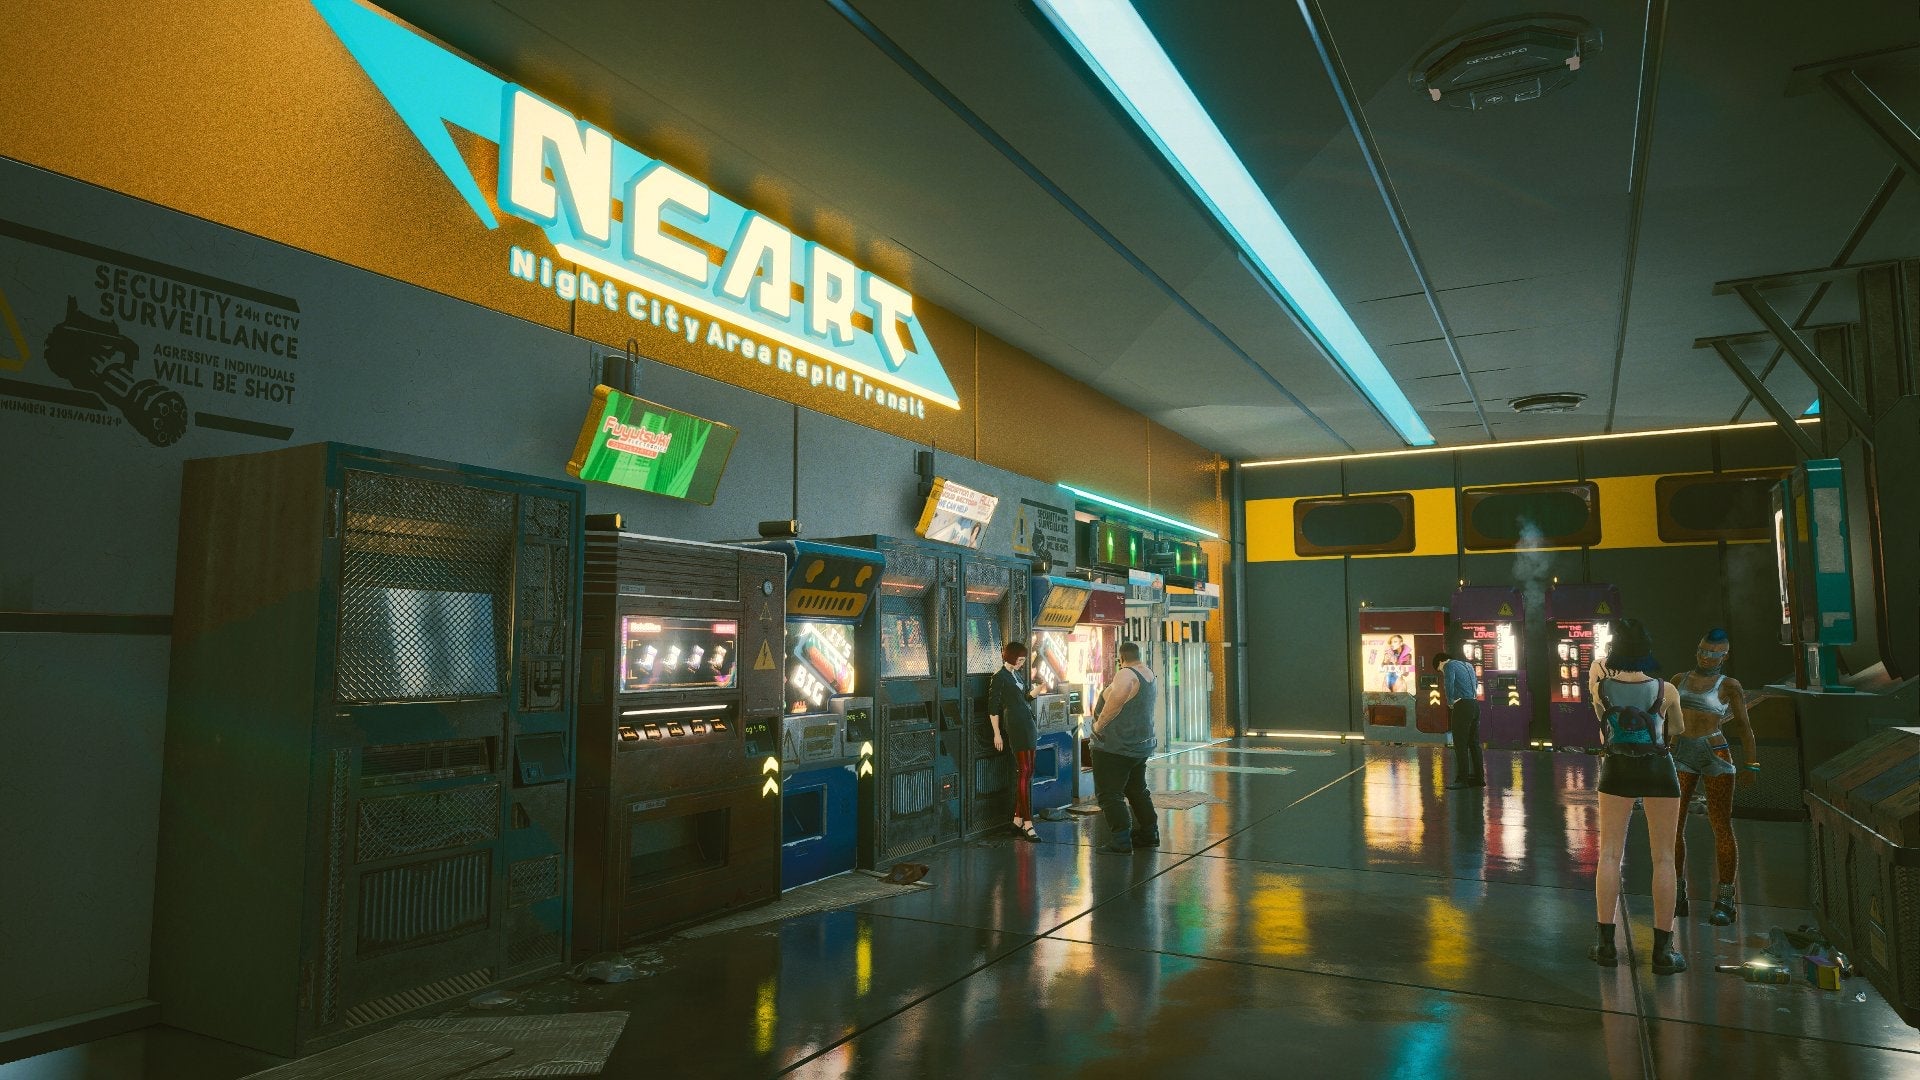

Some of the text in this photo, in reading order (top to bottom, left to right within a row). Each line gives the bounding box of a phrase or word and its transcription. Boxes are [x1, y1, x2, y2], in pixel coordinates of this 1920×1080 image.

[501, 83, 913, 369] NCART
[94, 265, 232, 319] SECURITY
[264, 311, 300, 332] CCTV
[100, 292, 299, 360] SURVEILLANCE
[509, 245, 926, 420] Night City Area Rapid Transit
[153, 343, 296, 384] AGRESSIVE INDIVIDUALS
[153, 358, 296, 405] WILL BE SHOT
[603, 416, 672, 448] Fuyutsuki
[793, 664, 825, 706] BIG
